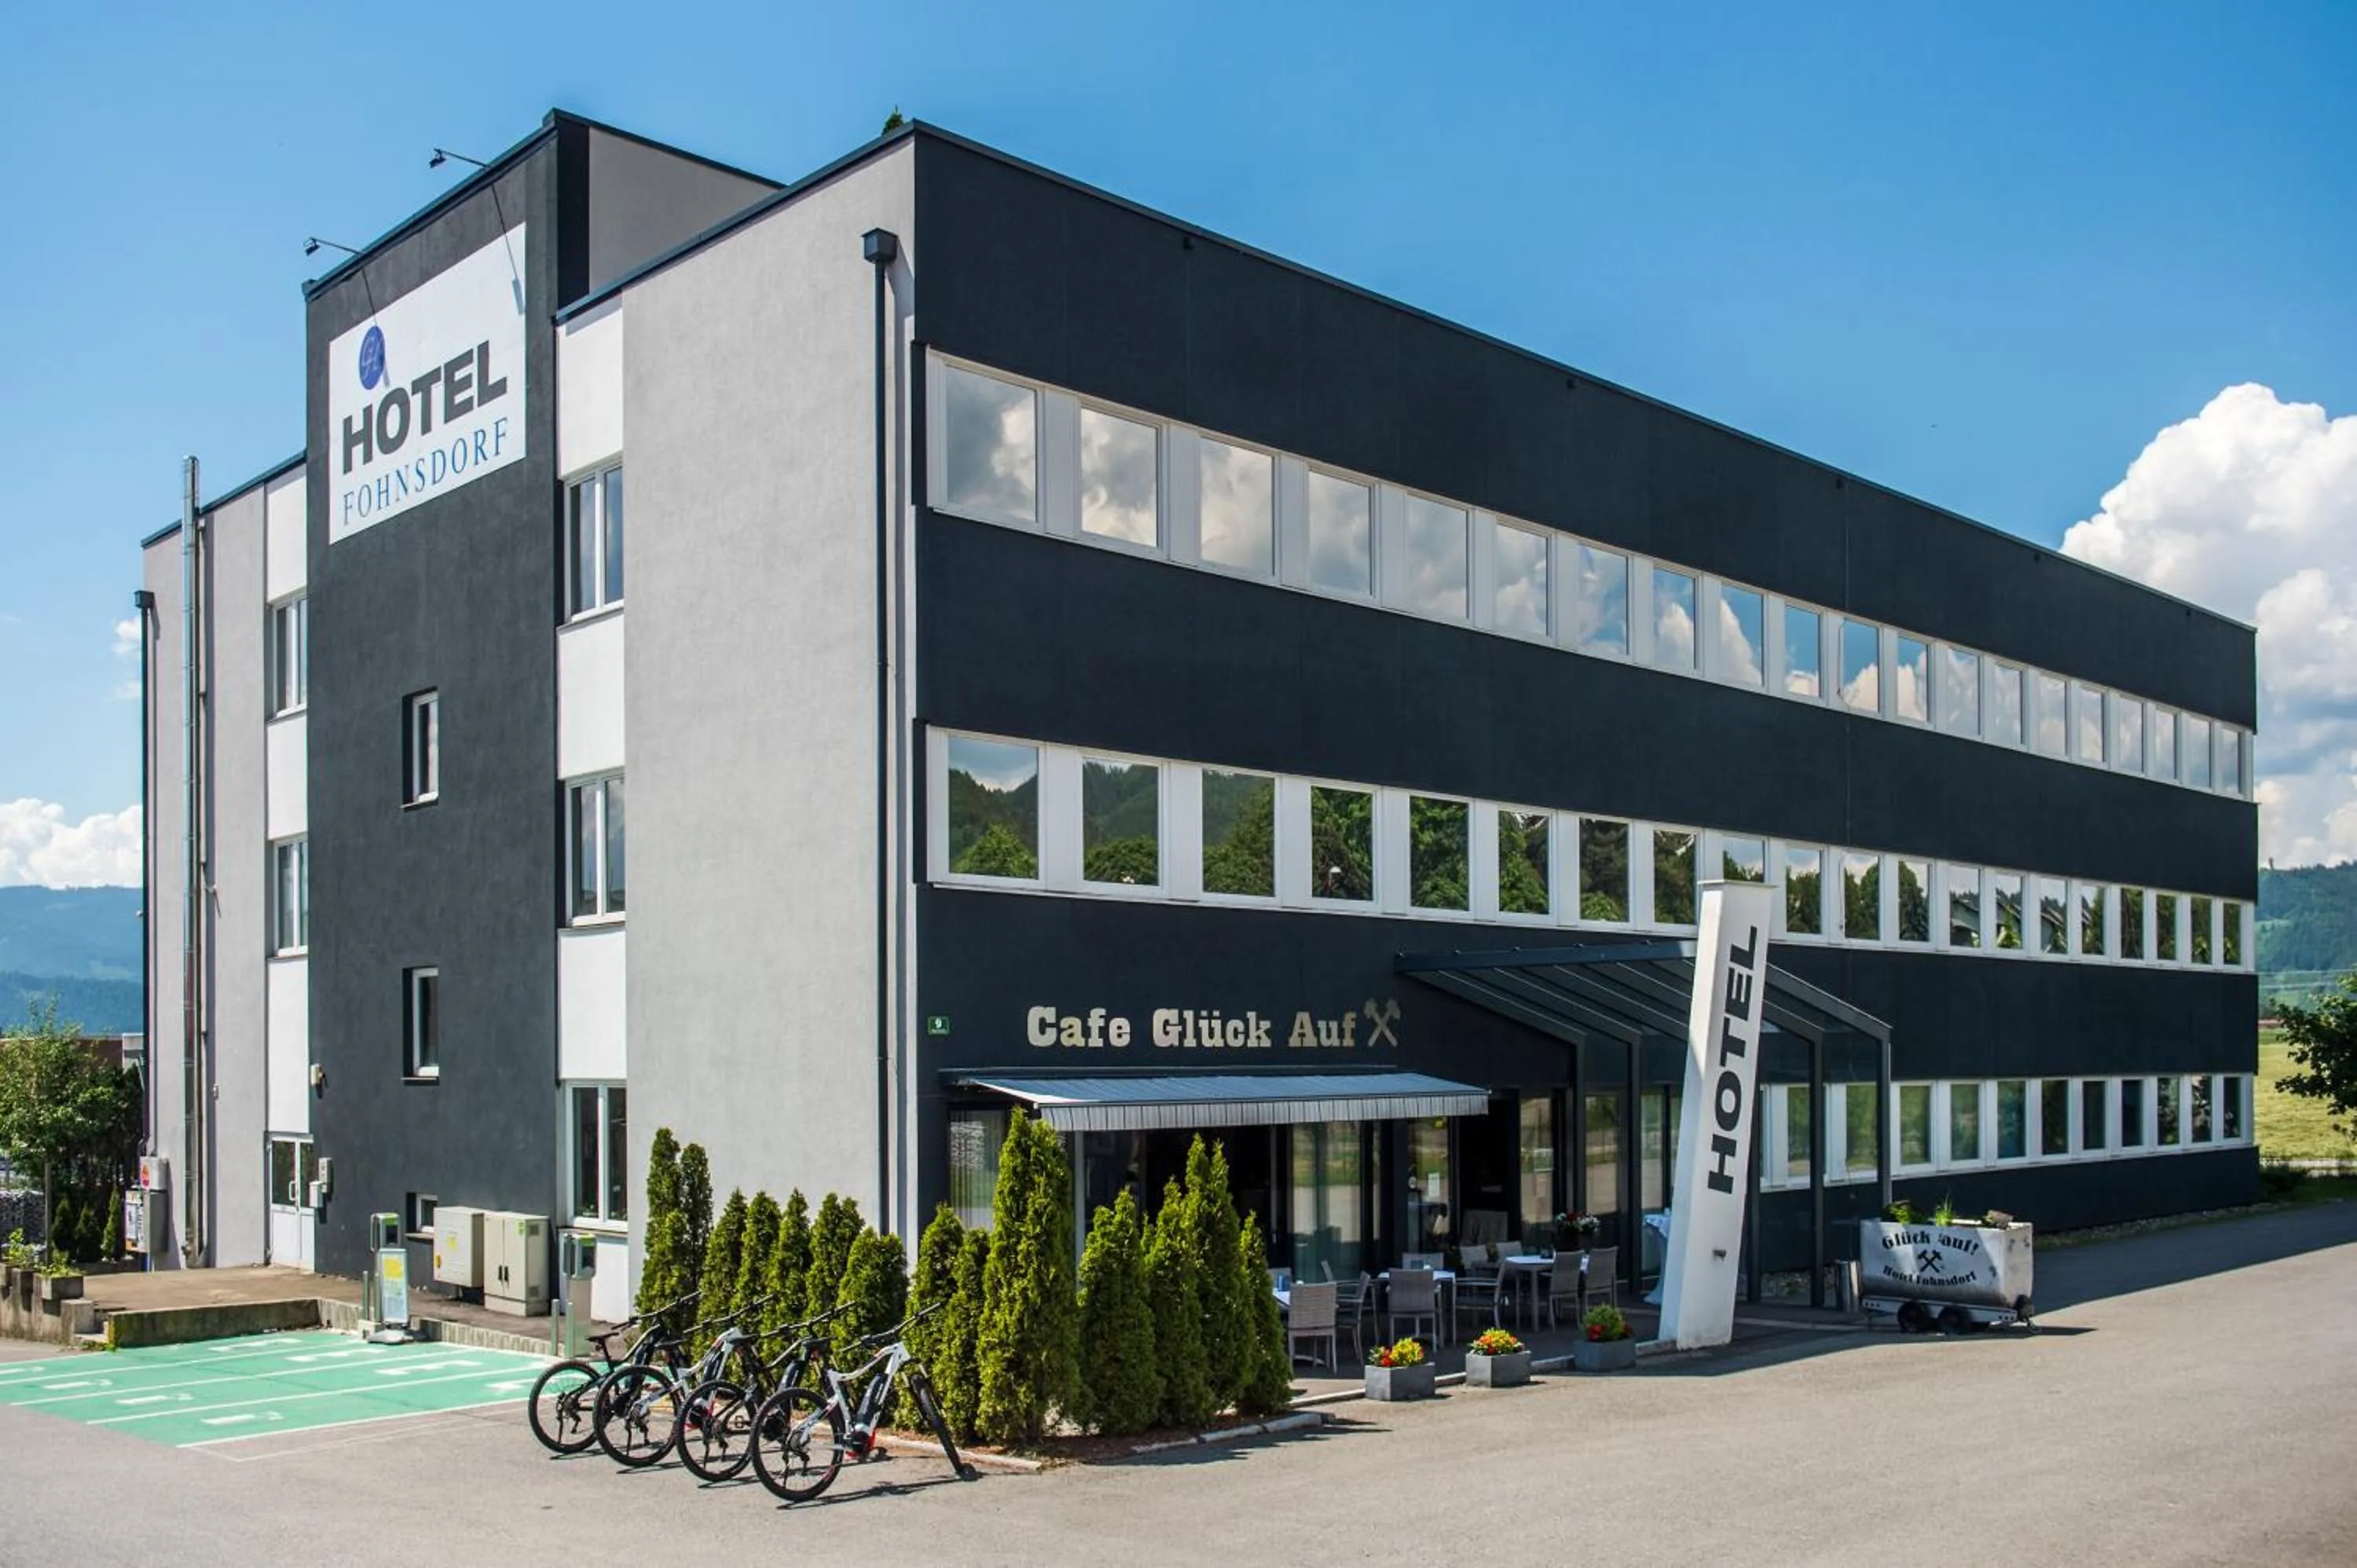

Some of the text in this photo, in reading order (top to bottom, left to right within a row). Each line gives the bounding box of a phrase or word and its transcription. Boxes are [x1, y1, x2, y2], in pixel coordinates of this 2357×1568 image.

[343, 340, 508, 475] HOTEL
[343, 417, 508, 526] FOHNSDORF
[935, 1017, 942, 1028] 9
[1027, 1006, 1357, 1047] Cafe Glück Auf
[1708, 925, 1757, 1194] HOTEL
[1882, 1230, 1930, 1250] Glück
